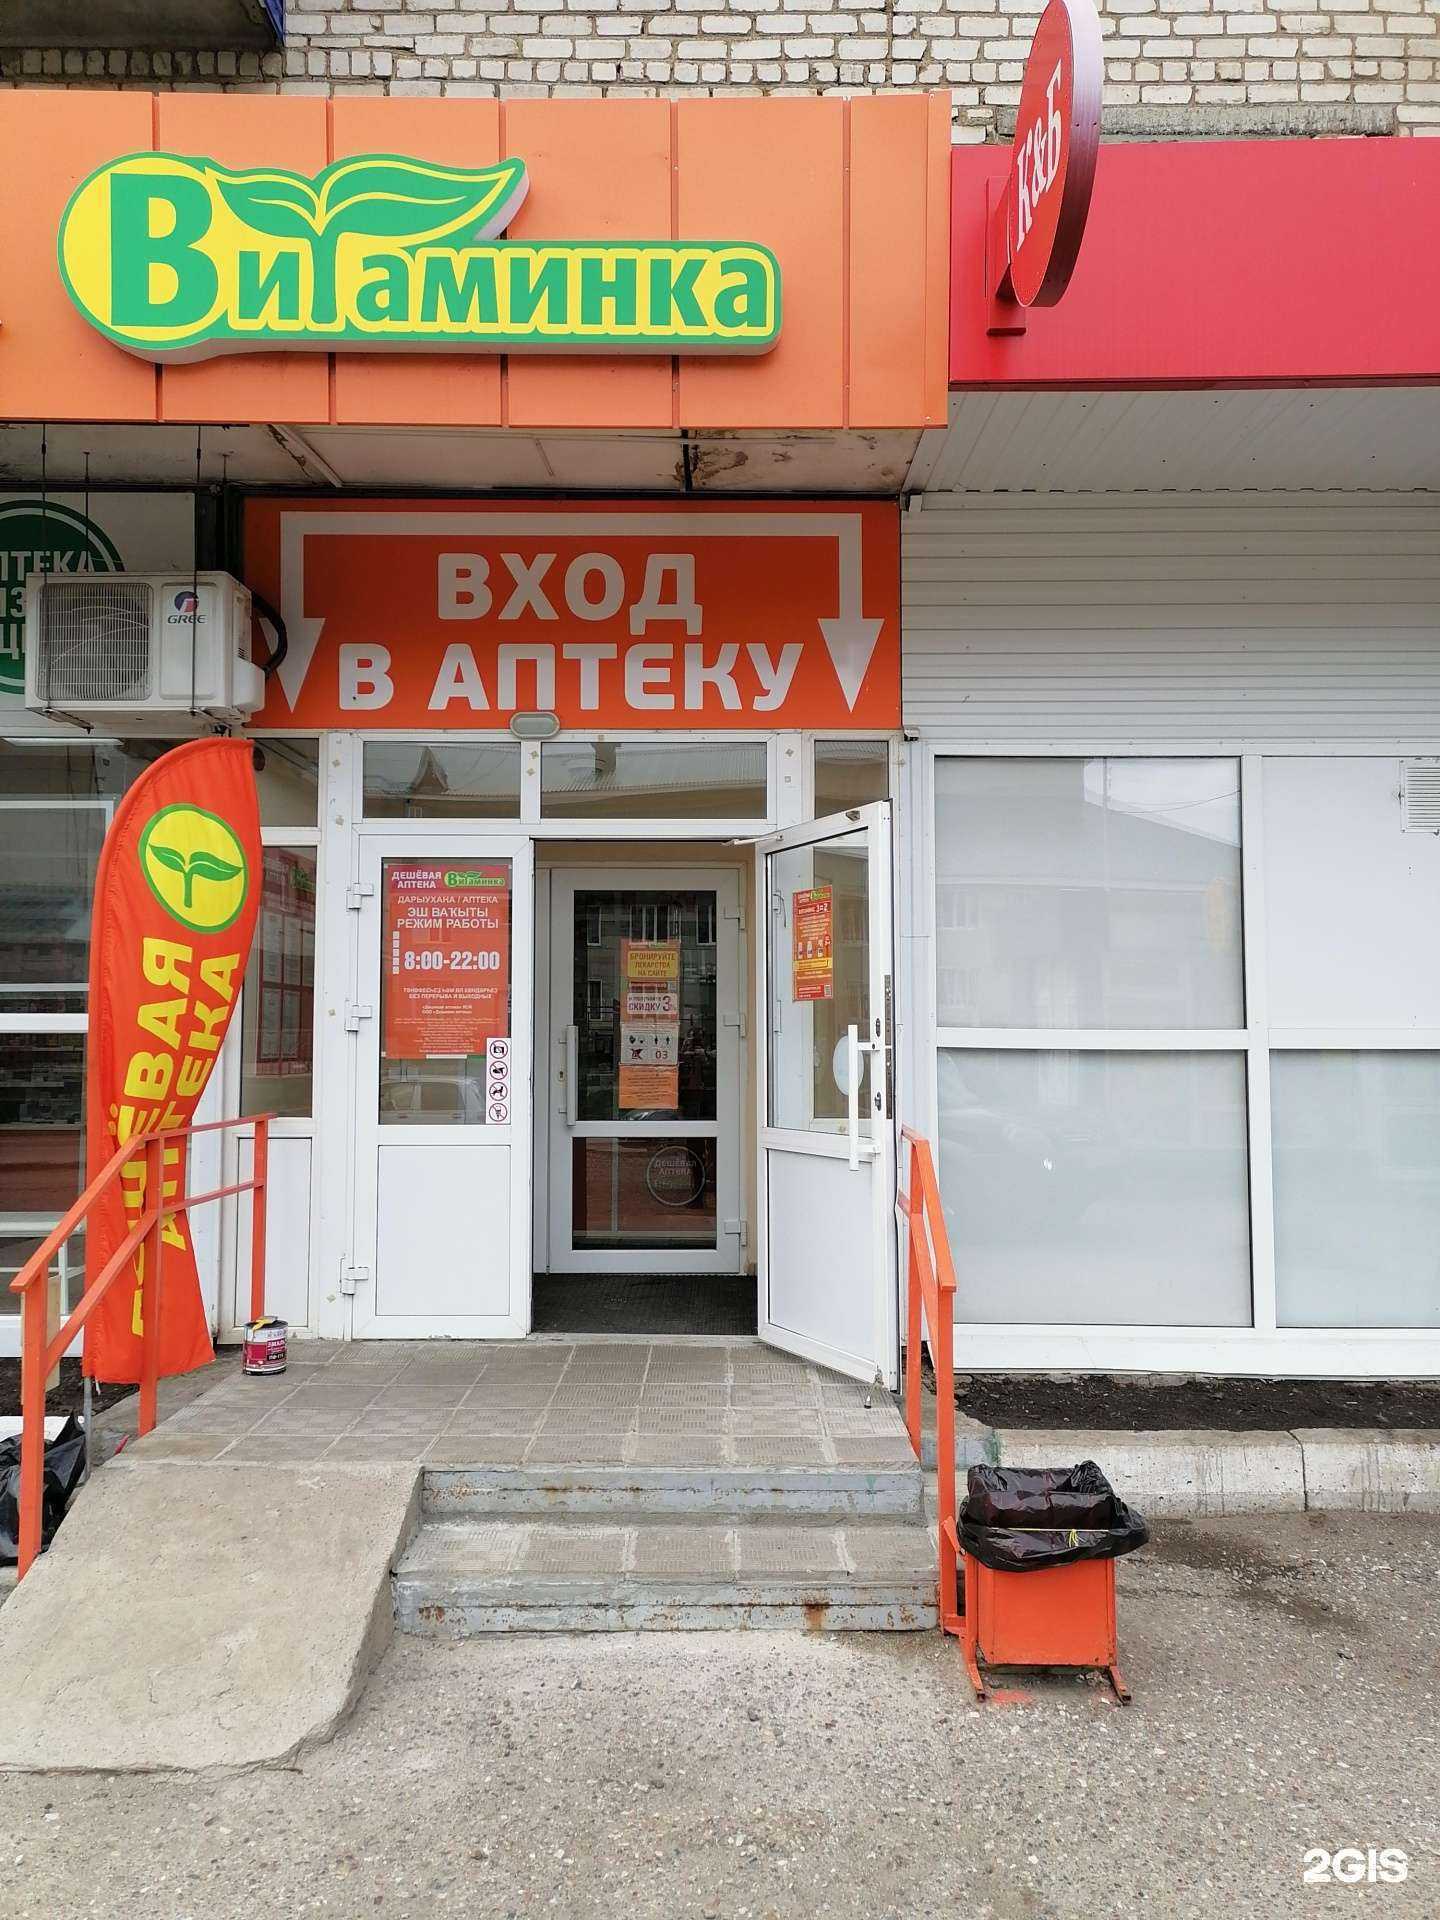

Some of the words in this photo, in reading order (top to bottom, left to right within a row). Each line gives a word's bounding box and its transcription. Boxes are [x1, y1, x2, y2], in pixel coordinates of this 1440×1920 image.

[109, 165, 768, 326] Витаминка
[437, 553, 703, 635] ВХОД
[167, 614, 207, 624] GREE
[338, 643, 395, 711] В
[427, 643, 805, 712] АПТЕКУ
[391, 869, 442, 881] ДЕШЁВАЯ
[397, 880, 437, 889] АПТЕКА
[462, 895, 499, 904] АПТЕКА
[407, 907, 429, 918] ЭШ
[397, 918, 443, 929] РЕЖИМ
[446, 918, 499, 929] РАБОТЫ
[404, 950, 500, 970] 8:00-22:00
[628, 1002, 661, 1011] СКИДКУ
[655, 1050, 668, 1059] 03
